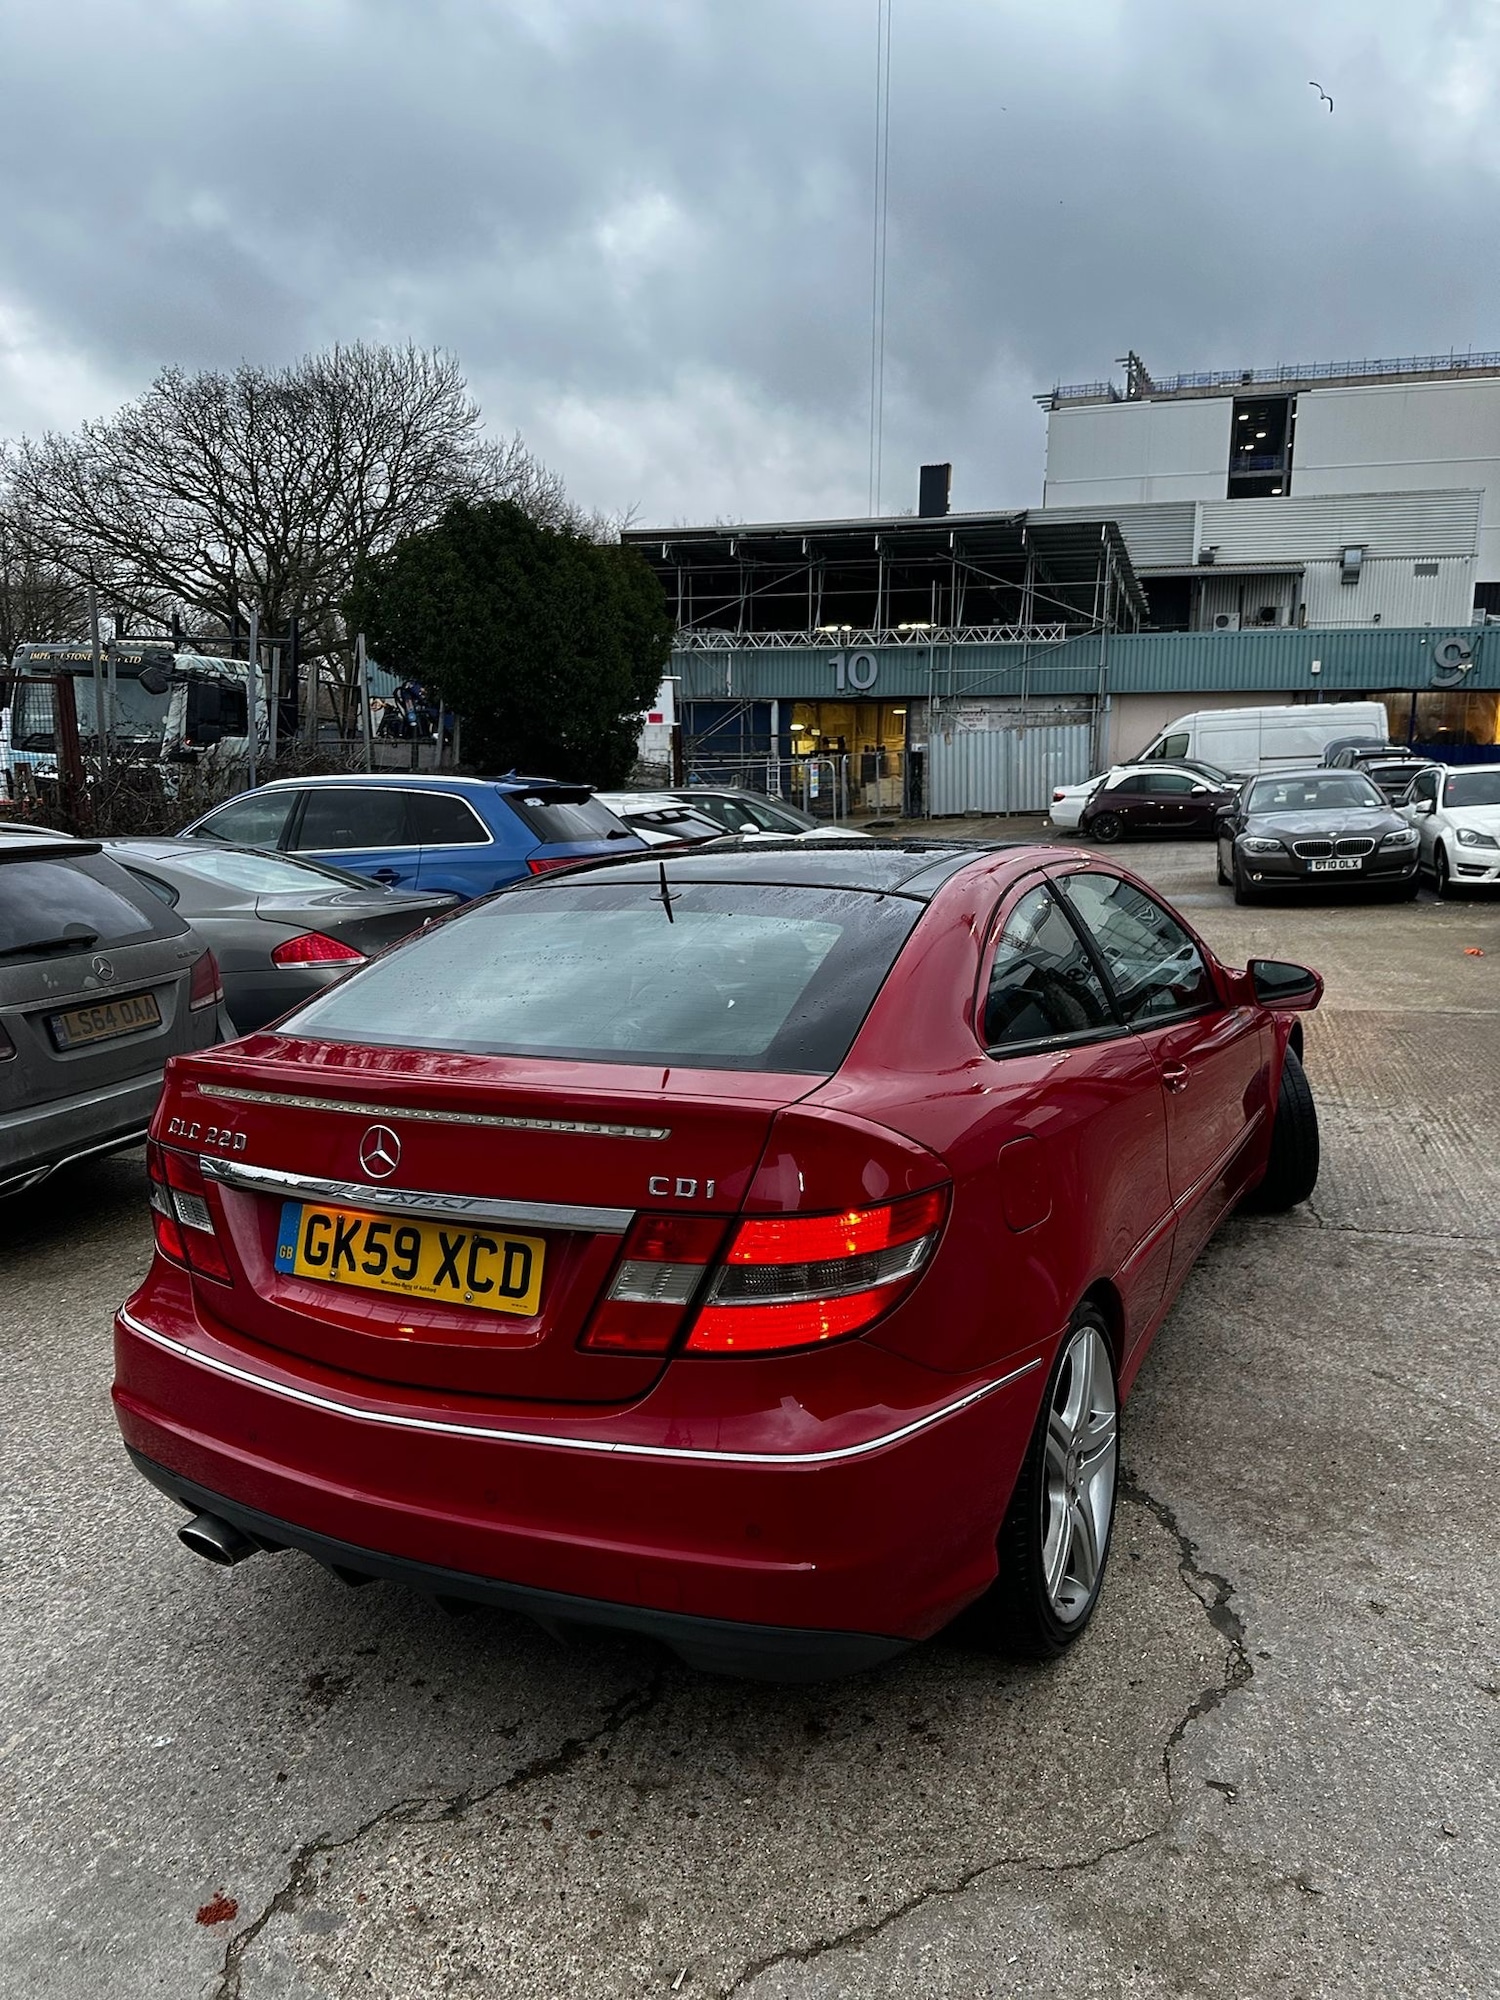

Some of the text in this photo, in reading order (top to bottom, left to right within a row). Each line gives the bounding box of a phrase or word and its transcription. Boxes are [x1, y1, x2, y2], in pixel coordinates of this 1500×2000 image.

[66, 652, 92, 661] STONE
[828, 650, 878, 689] 10
[1431, 637, 1471, 687] 9
[63, 1005, 118, 1038] LS64
[168, 1117, 247, 1150] CLC 220
[649, 1176, 715, 1198] CDI
[280, 1245, 294, 1259] GB
[304, 1213, 533, 1299] GK59 XCD
